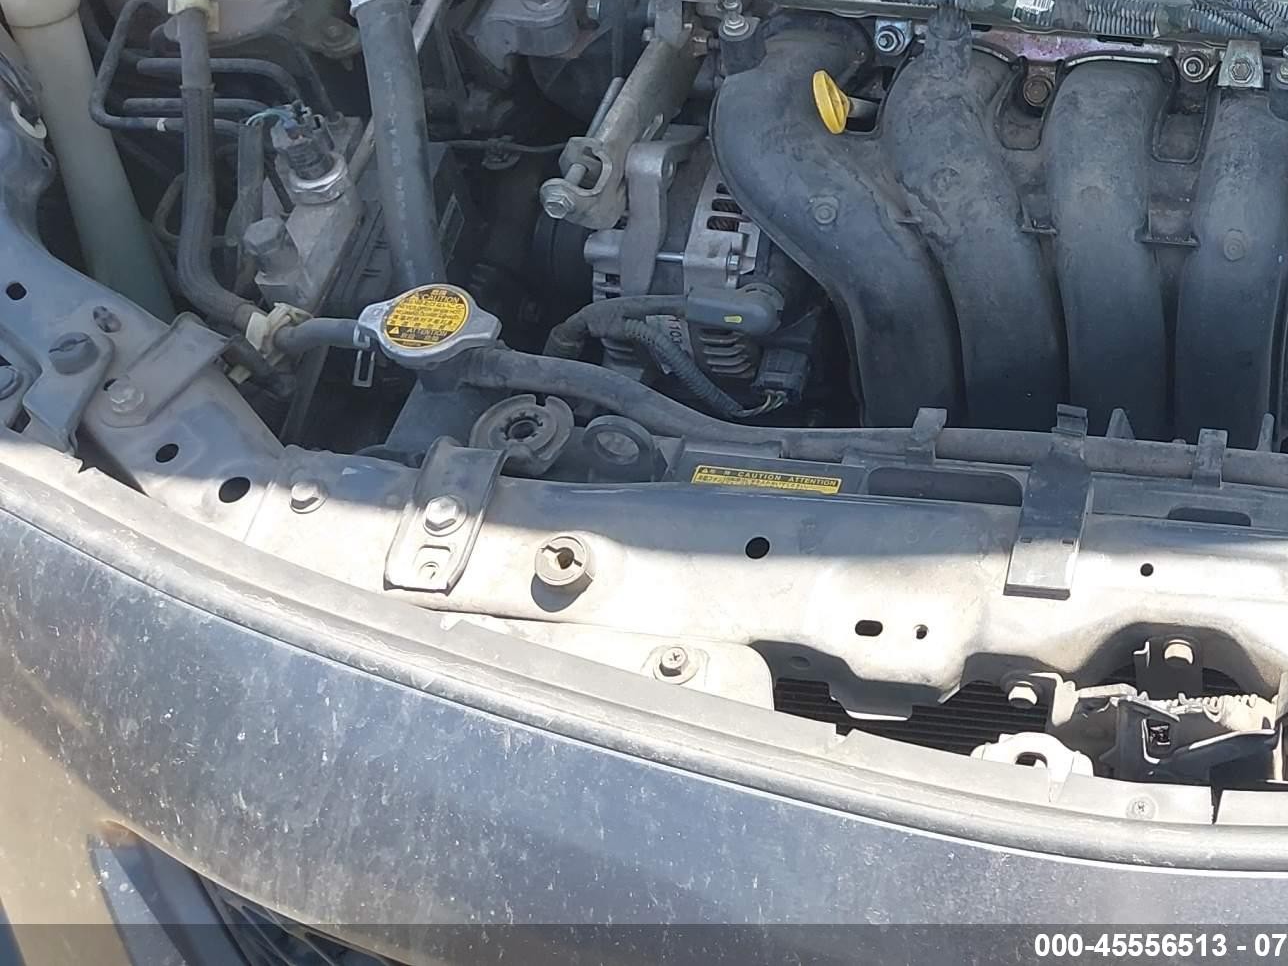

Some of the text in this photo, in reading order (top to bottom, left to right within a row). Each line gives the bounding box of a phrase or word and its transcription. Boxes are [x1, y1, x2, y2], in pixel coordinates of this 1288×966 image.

[421, 293, 460, 303] CAUTION
[406, 328, 448, 337] ATTENTION
[737, 471, 782, 481] CAUTION
[788, 477, 837, 487] ATTENTION
